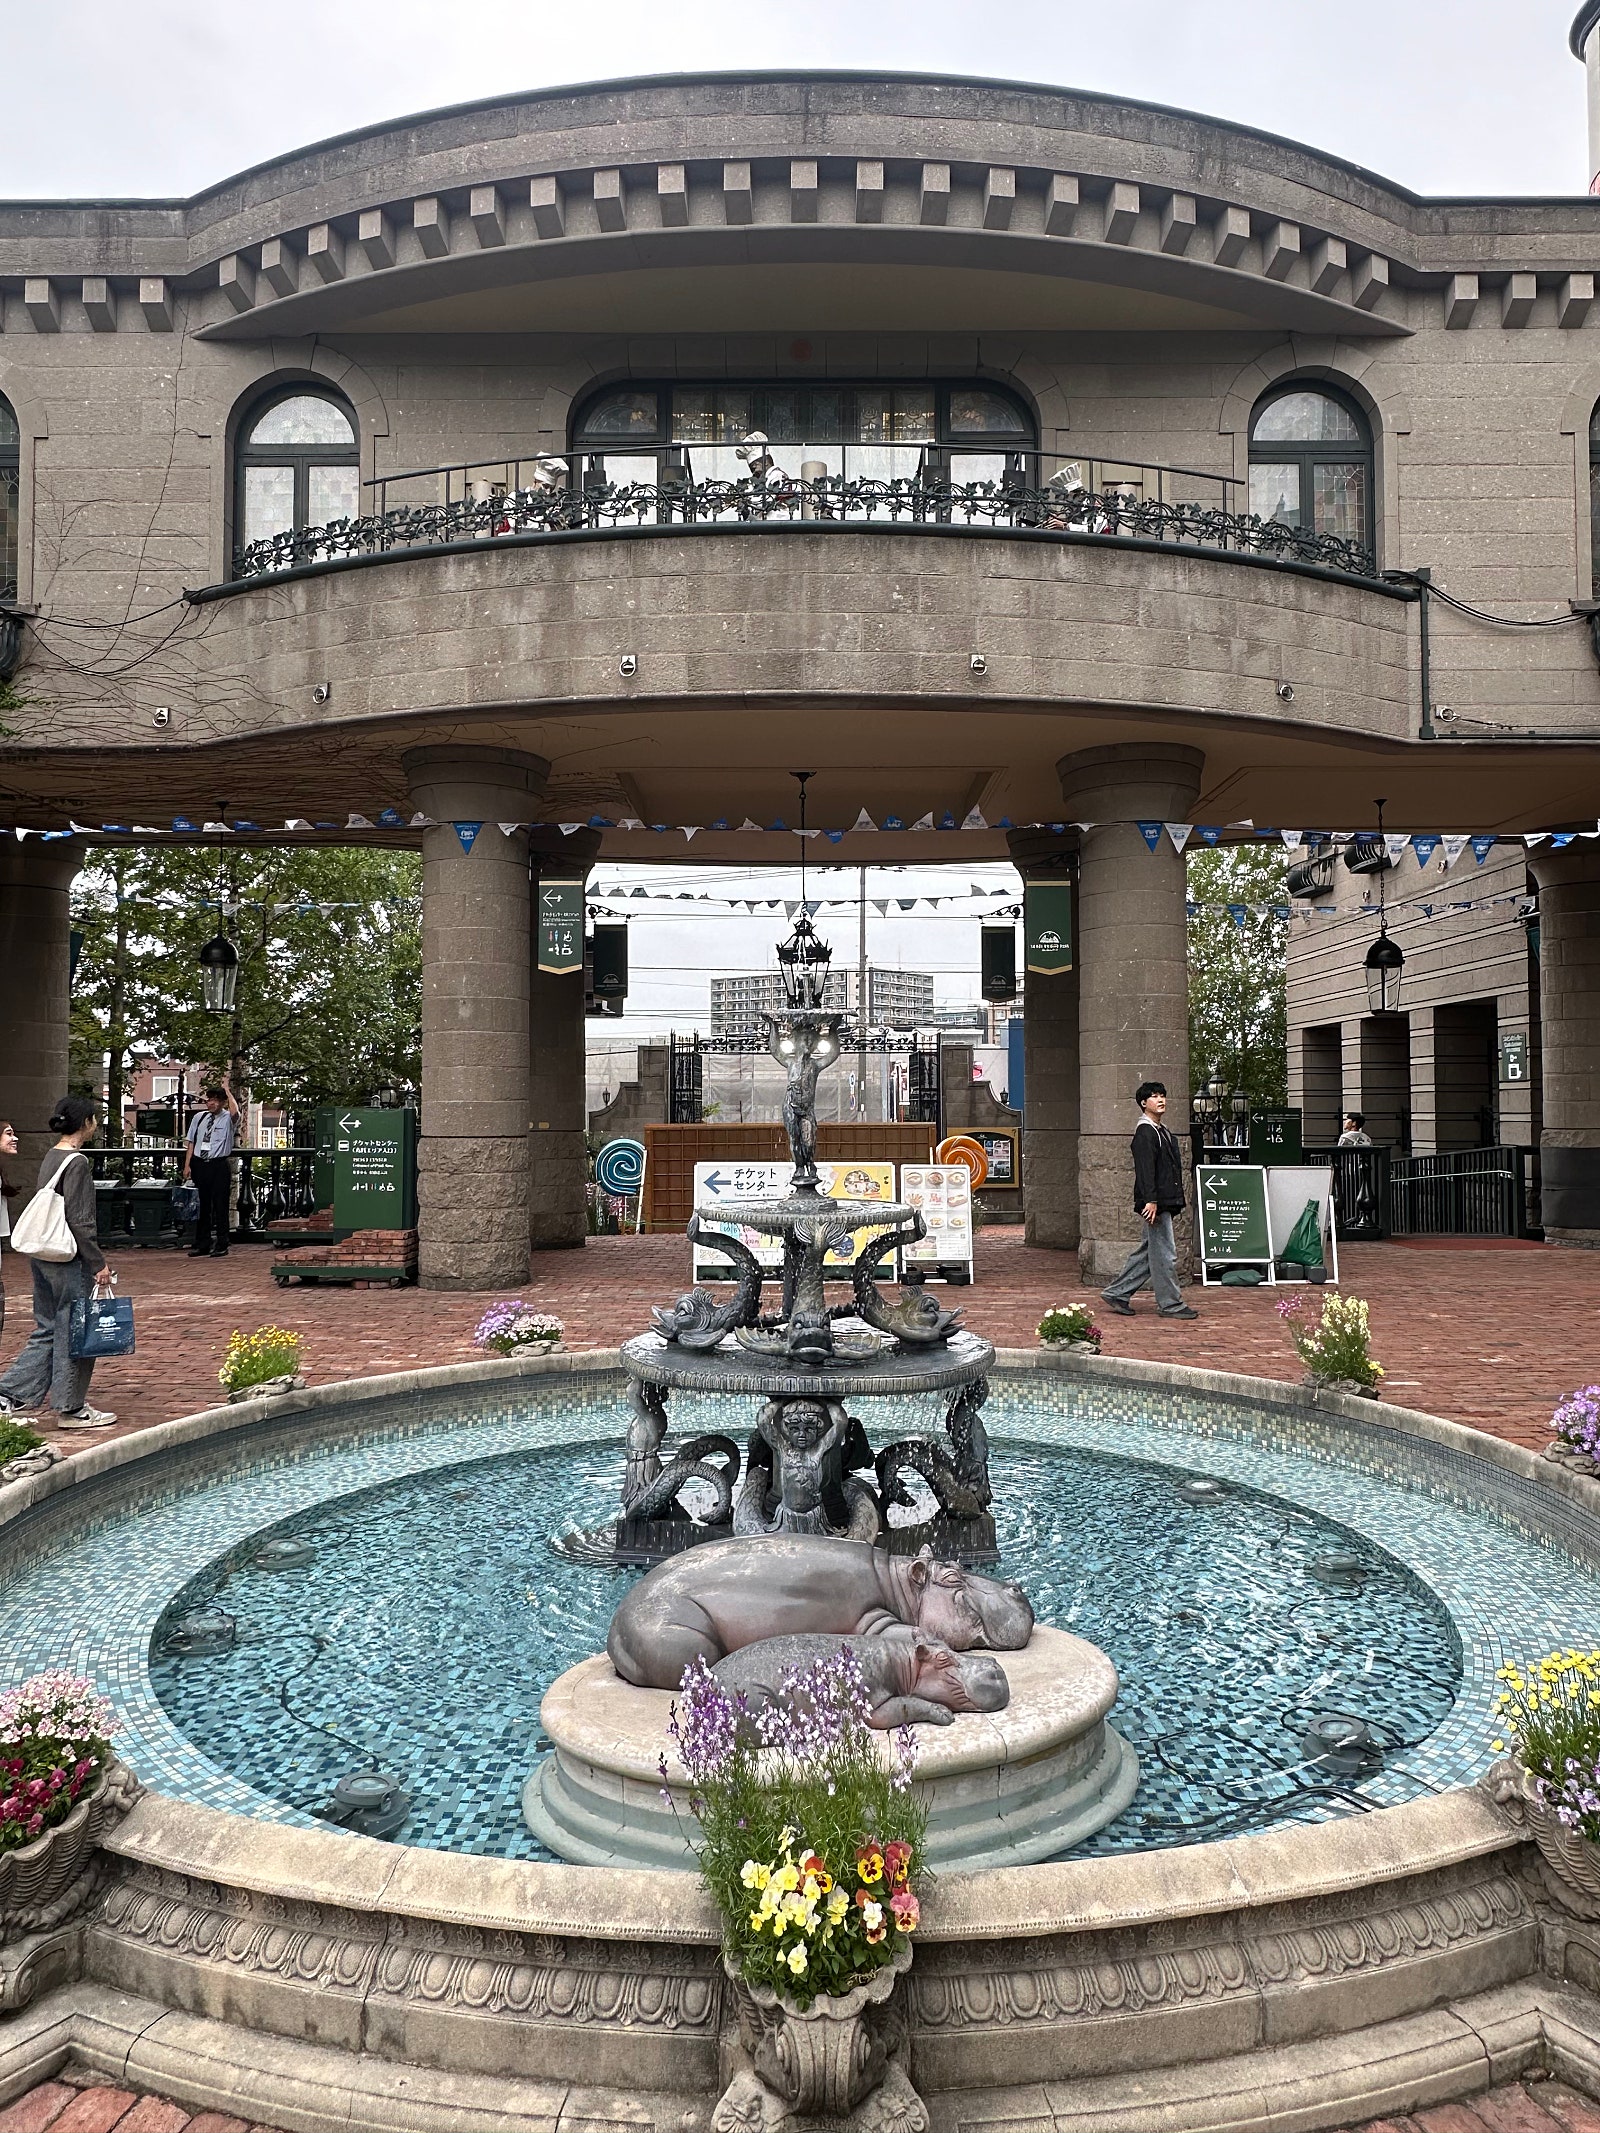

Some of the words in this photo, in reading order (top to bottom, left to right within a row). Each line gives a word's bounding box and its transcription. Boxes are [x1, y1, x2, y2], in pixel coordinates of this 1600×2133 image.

[734, 1168, 777, 1179] チケット
[733, 1181, 778, 1191] センター
